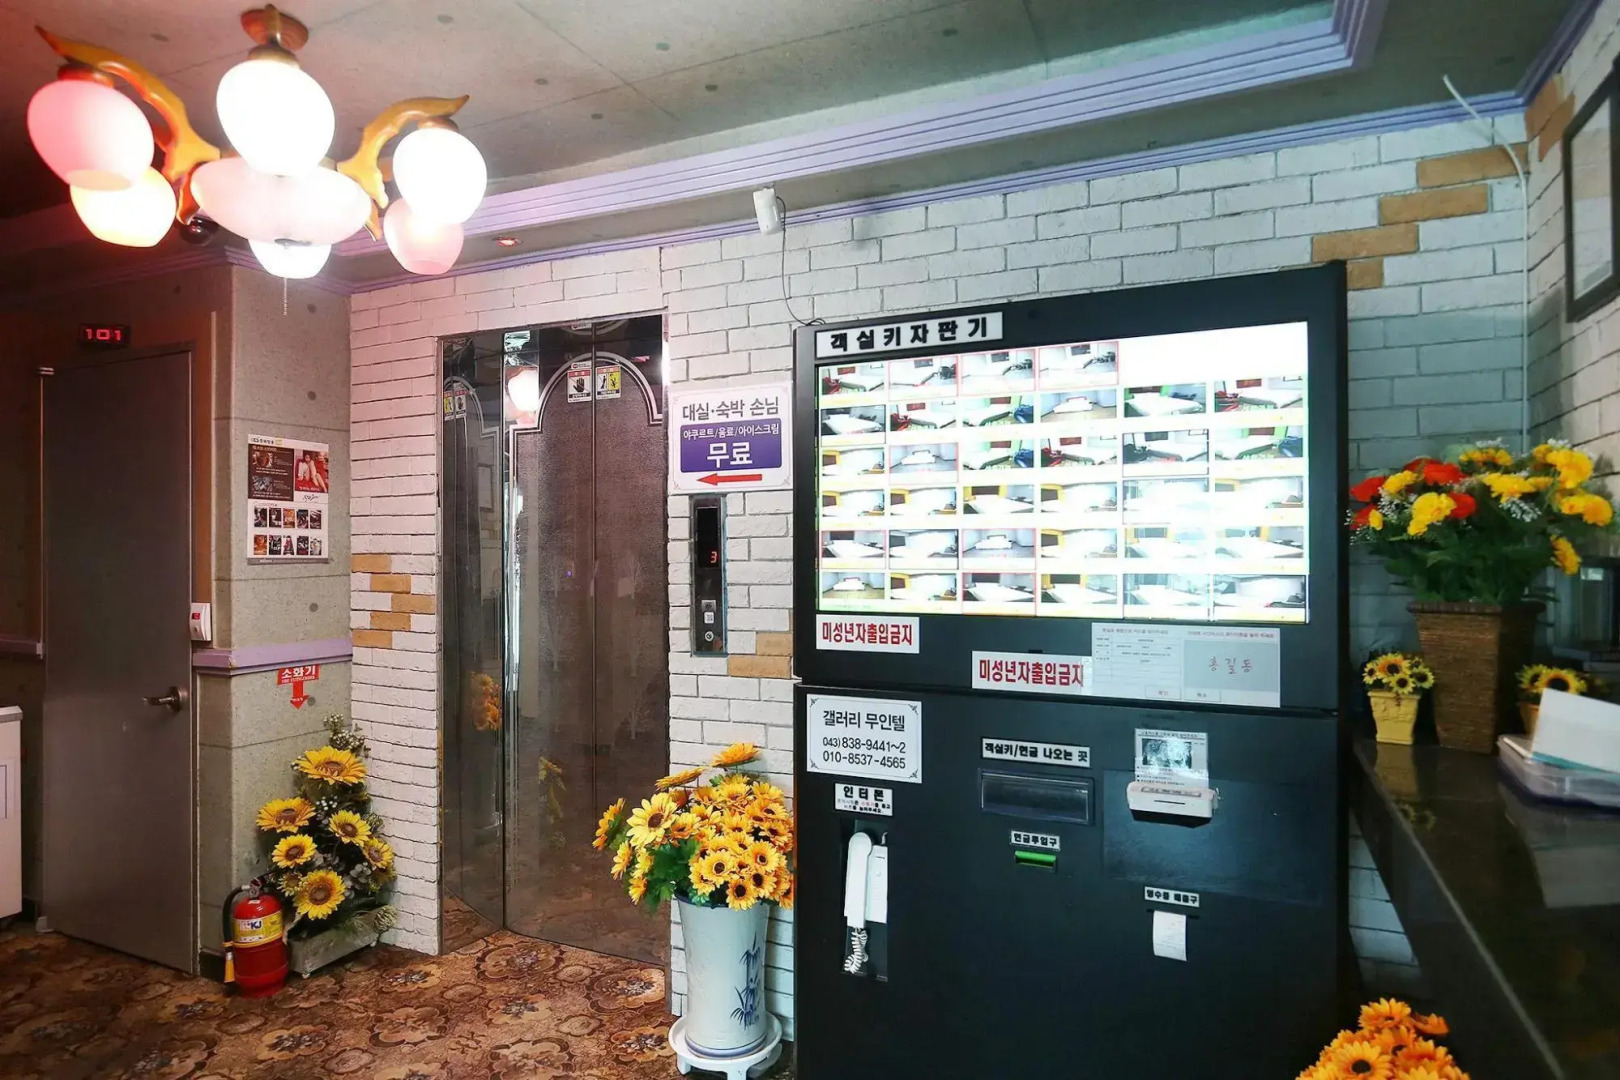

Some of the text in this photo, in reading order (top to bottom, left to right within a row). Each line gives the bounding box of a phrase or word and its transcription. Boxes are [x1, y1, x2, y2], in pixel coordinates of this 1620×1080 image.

[85, 328, 122, 341] 101
[830, 316, 988, 352] 객실키자판기
[682, 396, 779, 422] 대실·숙박 손님
[706, 441, 753, 468] 무료
[710, 551, 718, 564] 3
[822, 621, 912, 646] 미성년자출입금지
[281, 665, 316, 679] 소화기
[979, 659, 1084, 687] 미성년자출입금지
[823, 710, 905, 732] 갤러리 무인텔
[822, 750, 906, 769] 010-8537-4565
[1043, 747, 1073, 761] 나오는
[1077, 750, 1088, 763] 곳
[843, 786, 884, 802] 인터폰
[1013, 832, 1058, 847] 현금투입구
